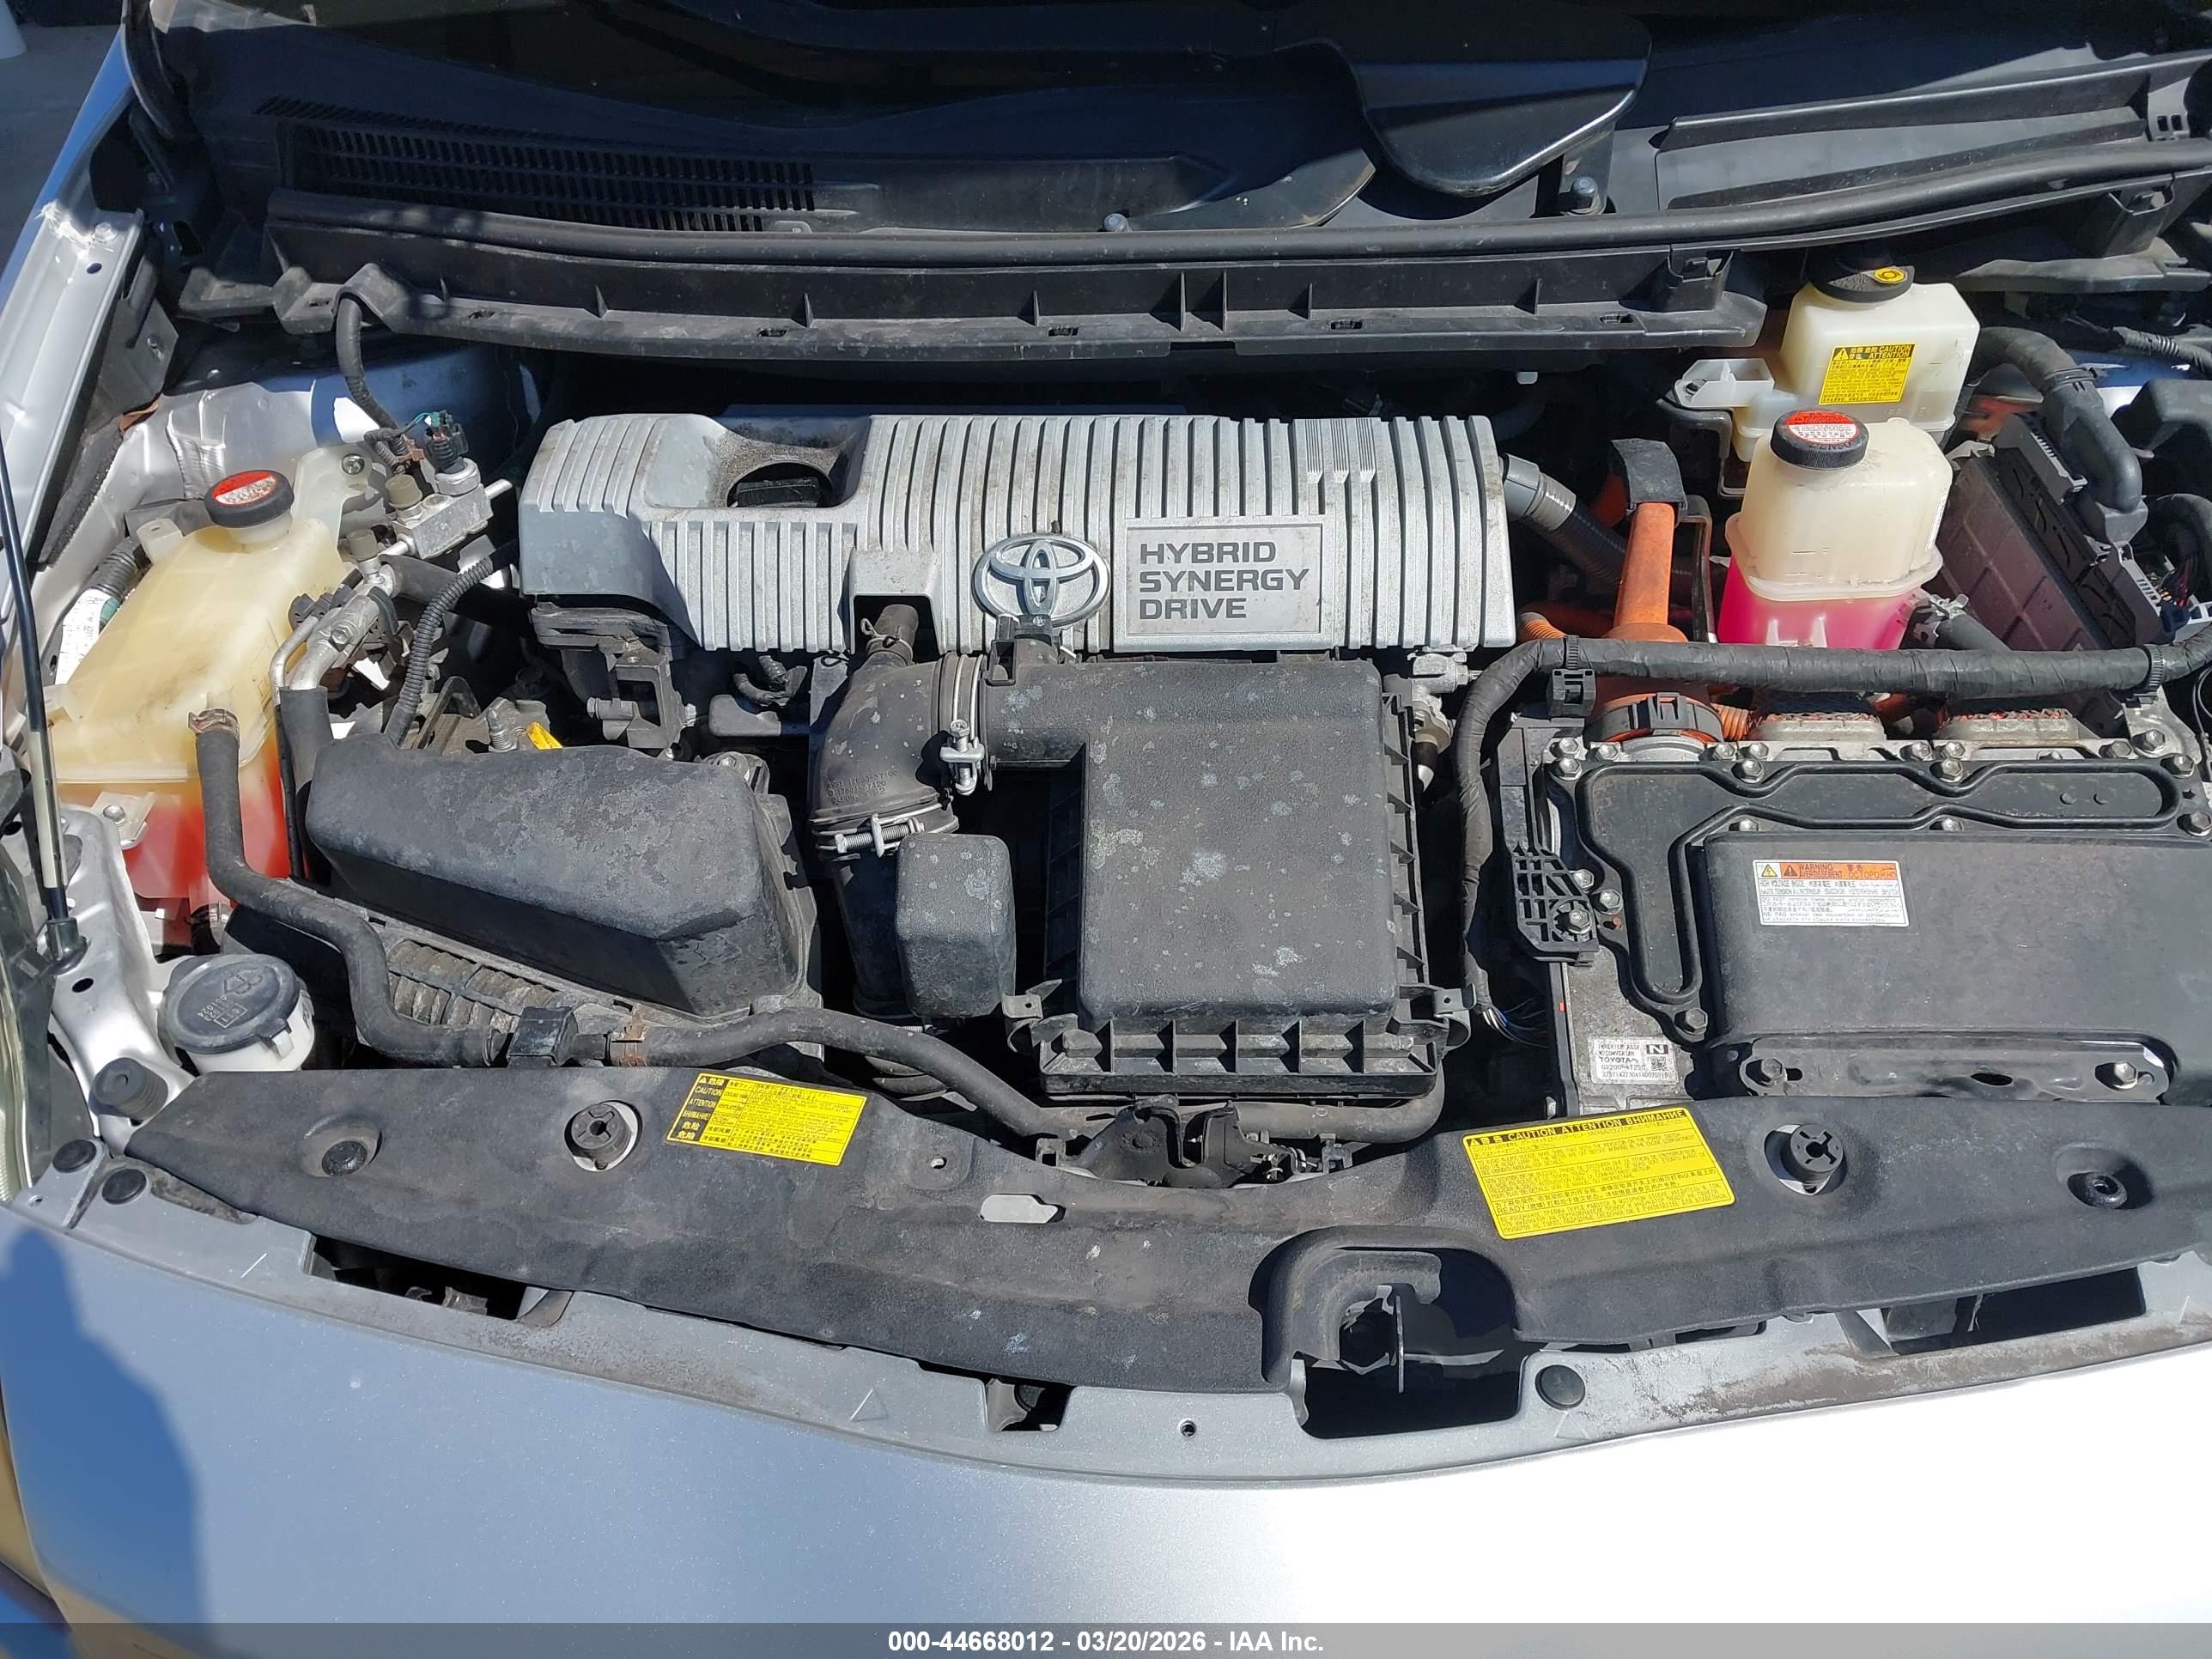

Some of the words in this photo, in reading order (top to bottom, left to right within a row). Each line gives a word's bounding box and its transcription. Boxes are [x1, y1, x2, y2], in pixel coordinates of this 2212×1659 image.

[1879, 344, 1911, 353] CAUTION
[1869, 351, 1910, 360] ATTENTION
[1139, 541, 1276, 564] HYBRID
[1139, 568, 1310, 592] SYNERGY
[1139, 598, 1247, 619] DRIVE
[694, 1085, 723, 1097] CAUTION
[689, 1098, 717, 1109] ATTENTION
[1508, 1127, 1556, 1141] CAUTION
[1561, 1119, 1622, 1133] ATTENTION
[1626, 1110, 1683, 1125] ВНИМАНИЕ
[1497, 1205, 1526, 1215] READY
